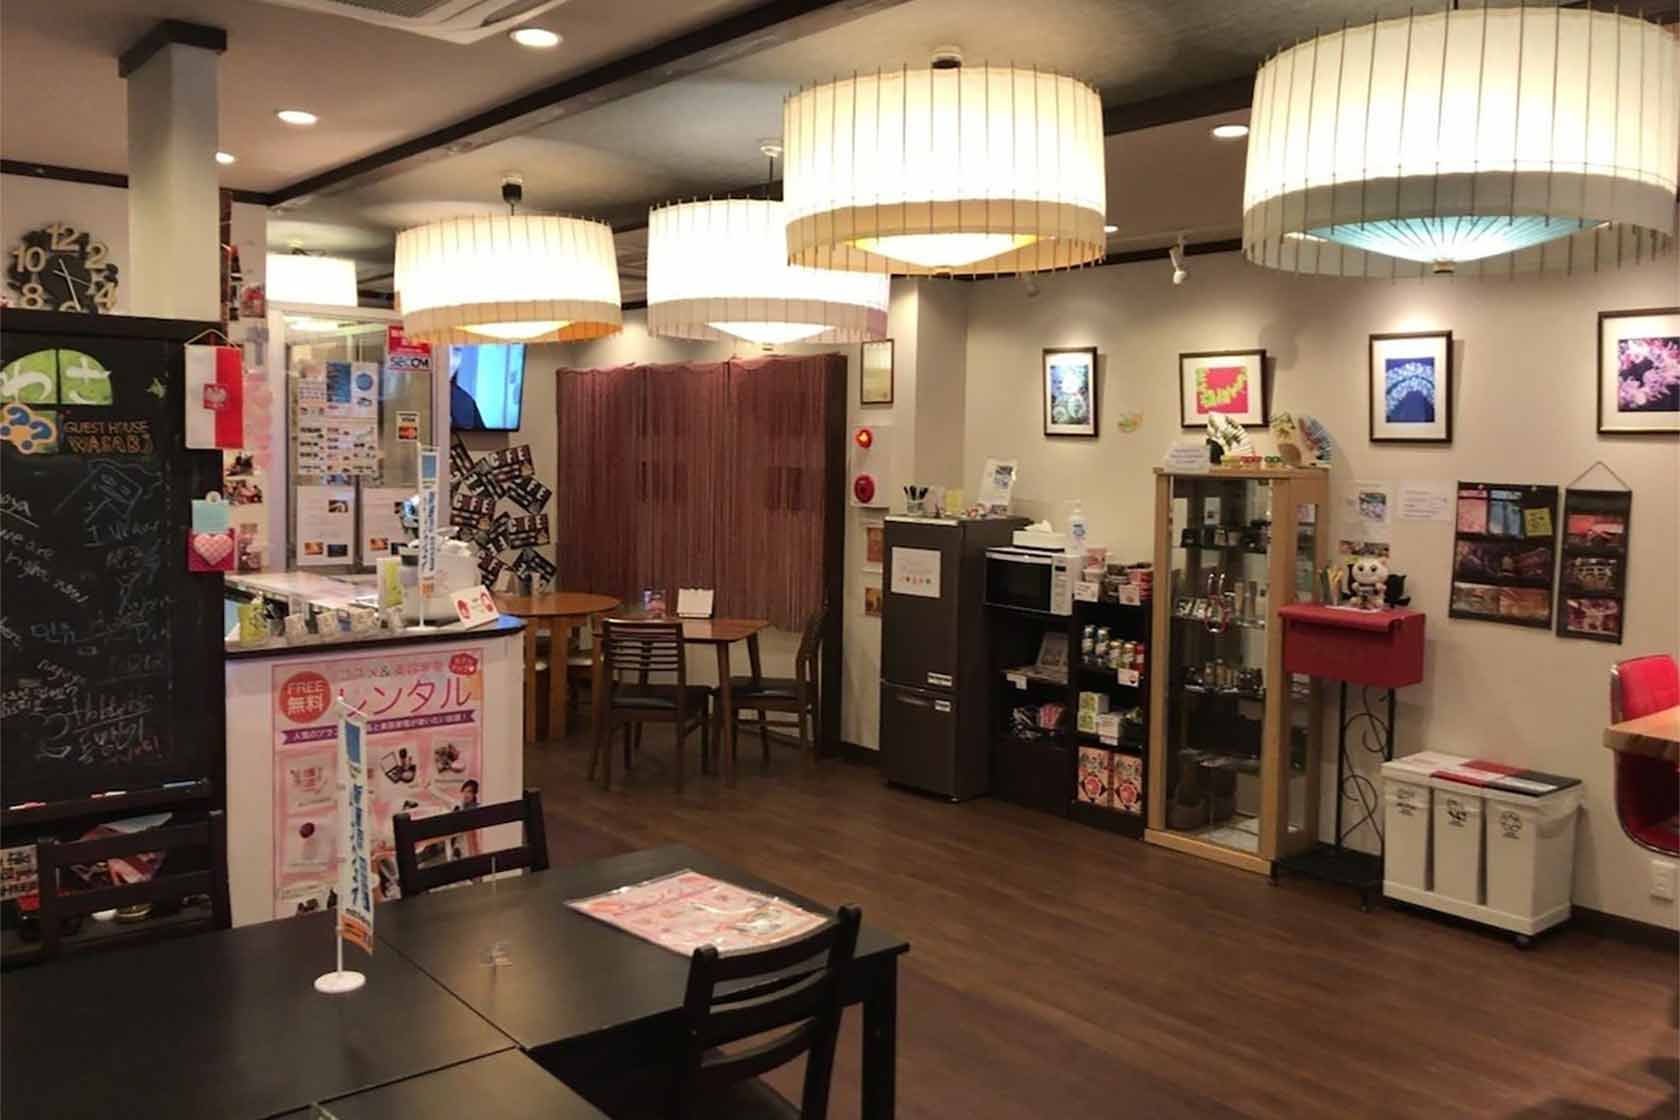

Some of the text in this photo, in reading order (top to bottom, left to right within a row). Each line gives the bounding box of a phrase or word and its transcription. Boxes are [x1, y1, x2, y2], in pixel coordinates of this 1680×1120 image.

[48, 223, 79, 250] 12
[13, 245, 46, 272] 10
[85, 241, 109, 270] 2
[21, 282, 44, 309] 8
[64, 421, 105, 434] GUEST
[288, 680, 325, 694] FREE
[287, 694, 323, 714] 無料
